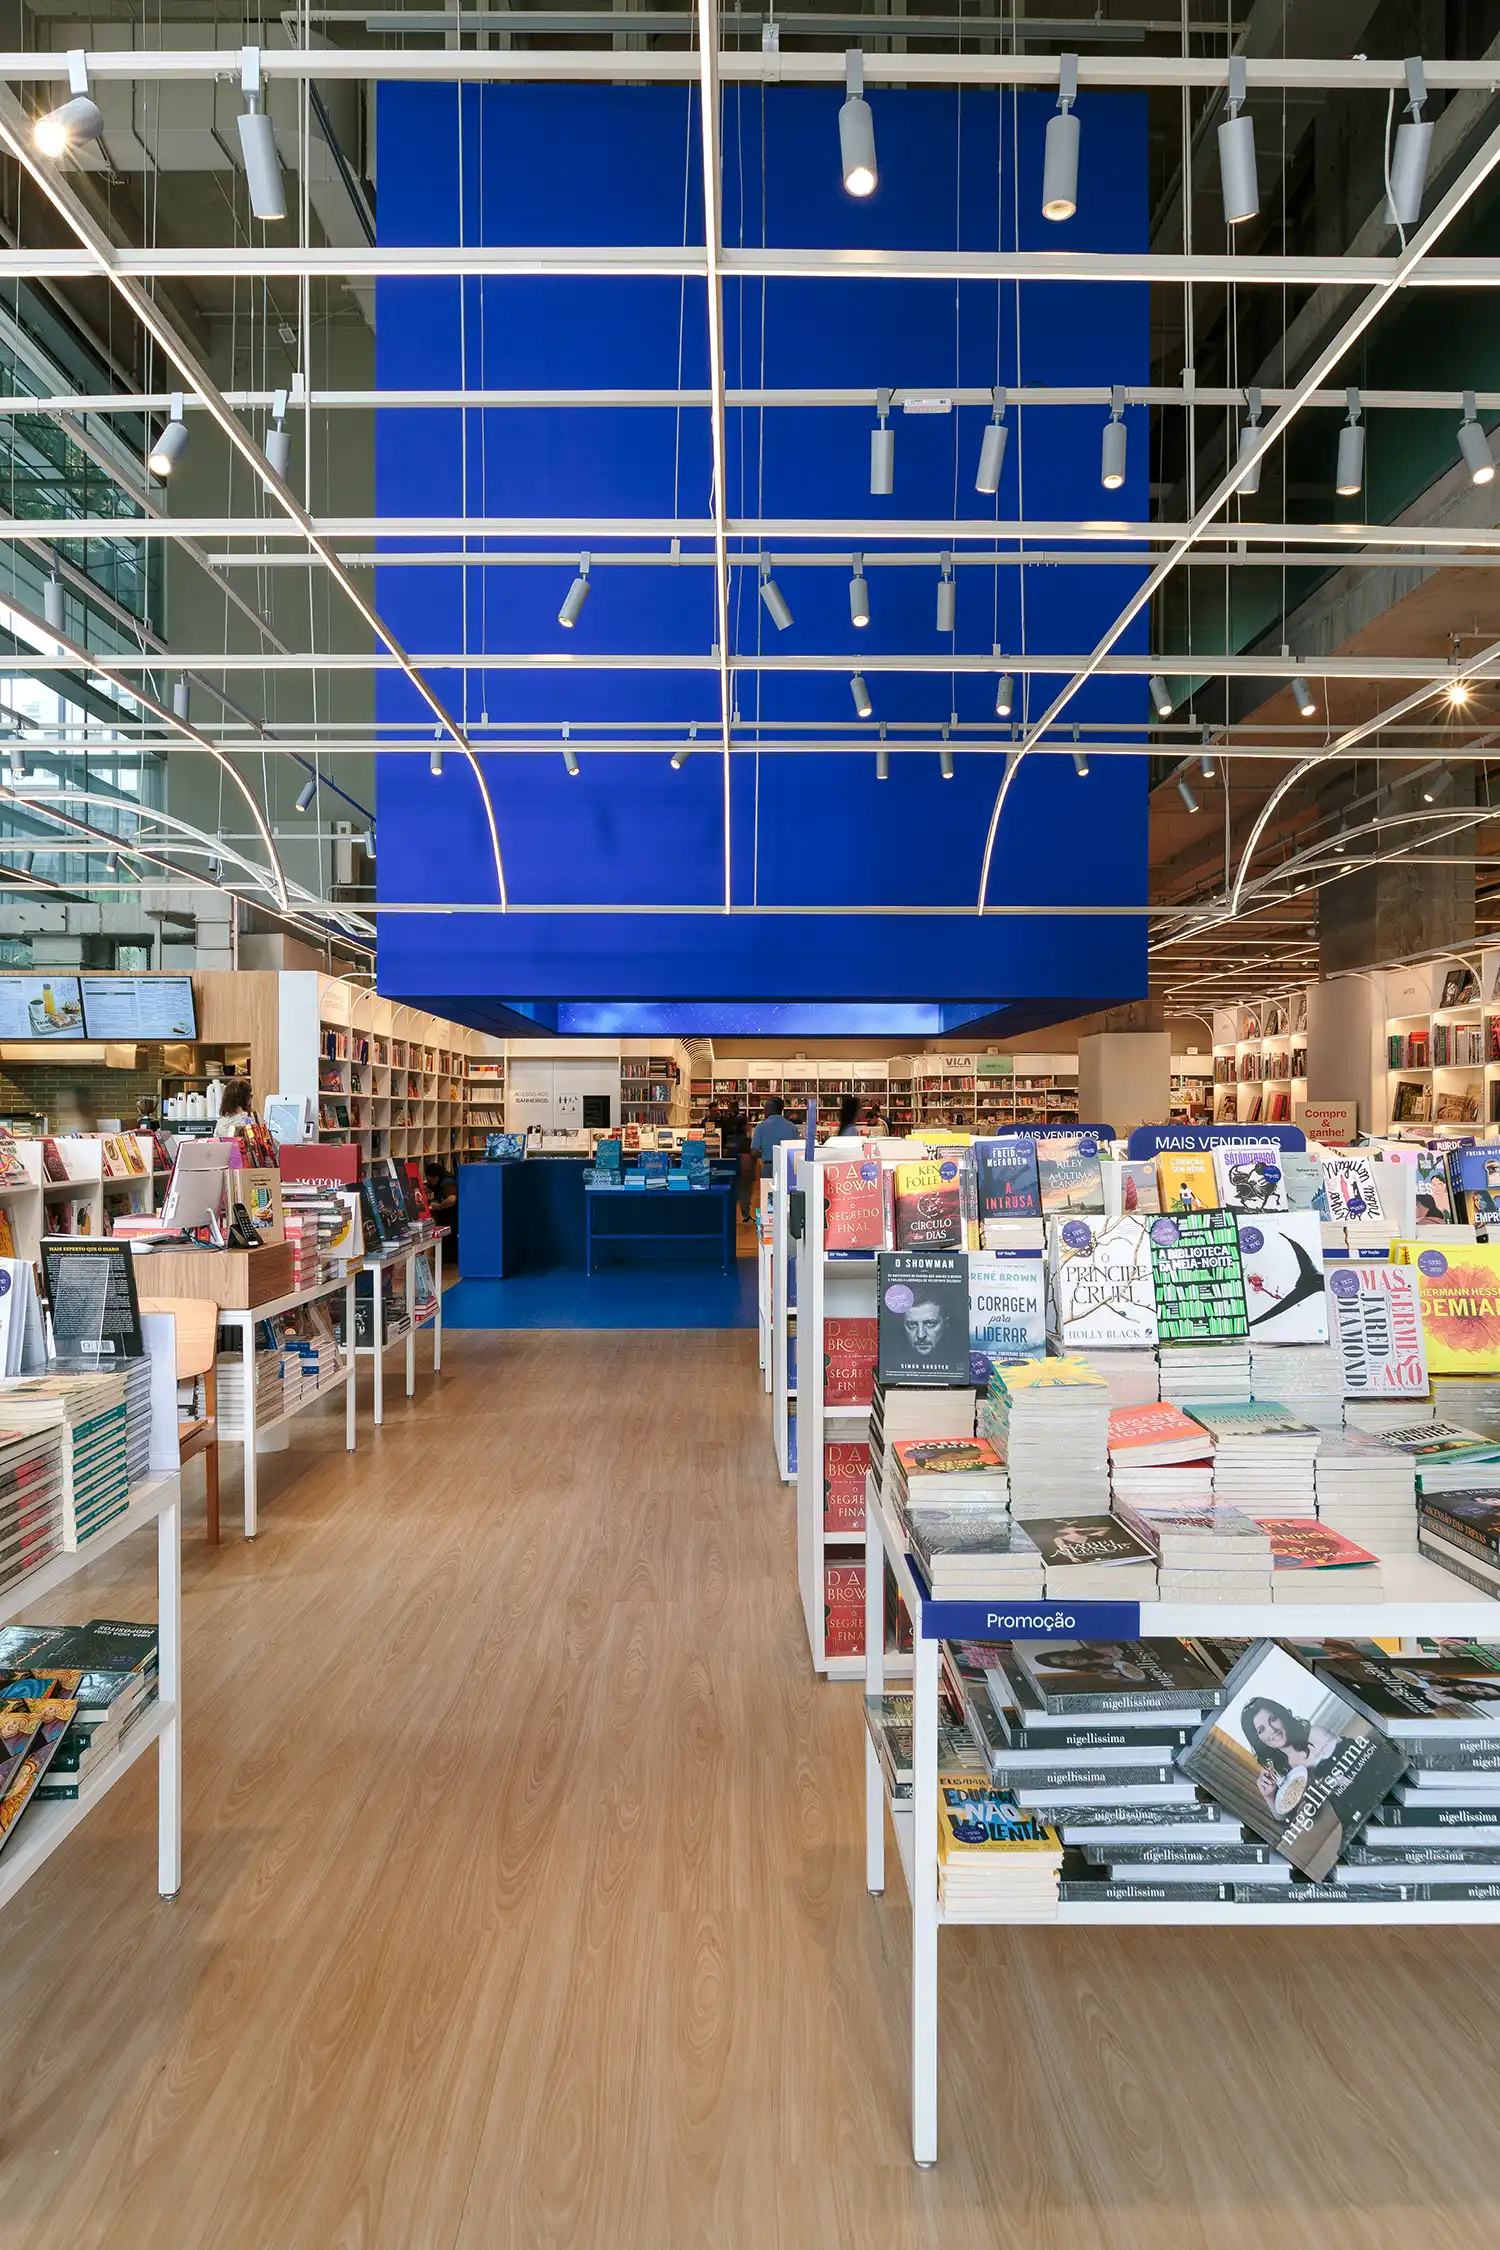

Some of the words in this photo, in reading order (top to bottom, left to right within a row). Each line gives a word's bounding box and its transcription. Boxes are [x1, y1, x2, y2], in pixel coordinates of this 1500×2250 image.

[1305, 1110, 1347, 1120] Compre
[1322, 1119, 1330, 1128] &
[1310, 1128, 1344, 1138] ganhe!
[1156, 1136, 1195, 1150] MAIS
[1198, 1136, 1282, 1150] VENDIDOS
[987, 1157, 1027, 1167] McFADDEN
[1056, 1159, 1083, 1170] RILEY
[1048, 1173, 1056, 1181] A
[1058, 1170, 1094, 1181] ÚLTIMA
[827, 1178, 878, 1195] BROWN
[1005, 1182, 1012, 1194] A
[985, 1194, 1034, 1210] INTRUSA
[1474, 1212, 1500, 1223] EMPR
[837, 1222, 869, 1233] FINAL
[910, 1219, 952, 1231] CÍRCULO
[926, 1230, 946, 1240] DIAS
[1101, 1253, 1110, 1263] O
[1159, 1250, 1167, 1259] A
[1167, 1246, 1230, 1260] BIBLIOTECA
[895, 1259, 901, 1268] O
[906, 1259, 954, 1269] SHOWMAN
[1159, 1263, 1172, 1272] DA
[1172, 1256, 1234, 1270] MEIA-NOITE
[968, 1270, 996, 1280] RENÉ
[1000, 1273, 1037, 1282] BROWN
[1073, 1286, 1140, 1304] CRUEL
[1419, 1288, 1470, 1296] HERMANN
[978, 1296, 1037, 1312] CORAGEM
[988, 1314, 1011, 1324] para
[1360, 1293, 1390, 1356] JARED
[976, 1326, 1027, 1343] LIDERAR
[1068, 1330, 1106, 1339] HOLLY
[1107, 1330, 1140, 1339] BLACK
[1337, 1294, 1368, 1386] DIAMOND
[828, 1338, 878, 1352] BROWN
[1383, 1362, 1422, 1388] AÇO
[830, 1494, 864, 1504] SEGRE
[838, 1507, 866, 1517] FINA
[1424, 1505, 1452, 1526] ASCENSÃO
[1452, 1521, 1464, 1532] DAS
[1465, 1525, 1487, 1546] TREVAS
[1272, 1546, 1330, 1554] OSAS
[1470, 1574, 1492, 1592] TREVAS
[828, 1588, 866, 1602] BROW
[829, 1619, 864, 1628] SEGRE
[987, 1612, 1076, 1632] Promoção
[838, 1632, 865, 1641] FINA
[1102, 1696, 1162, 1710] nigellissima
[1066, 1732, 1126, 1745] nigellissima
[1460, 1739, 1500, 1753] nigelliss
[1472, 1756, 1500, 1769] nigell
[1334, 1772, 1357, 1797] NIGELLA
[1355, 1744, 1378, 1772] LAWSON
[1047, 1771, 1106, 1784] nigellissima
[1281, 1735, 1370, 1846] nigellissima
[964, 1800, 1022, 1823] NÃO
[1439, 1810, 1498, 1824] nigellissima
[1143, 1849, 1203, 1862] nigellissima
[1405, 1849, 1464, 1863] nigellissima
[1106, 1886, 1166, 1899] nigellissima
[1288, 1887, 1348, 1900] nigellissima
[1468, 1885, 1500, 1898] nigelli
